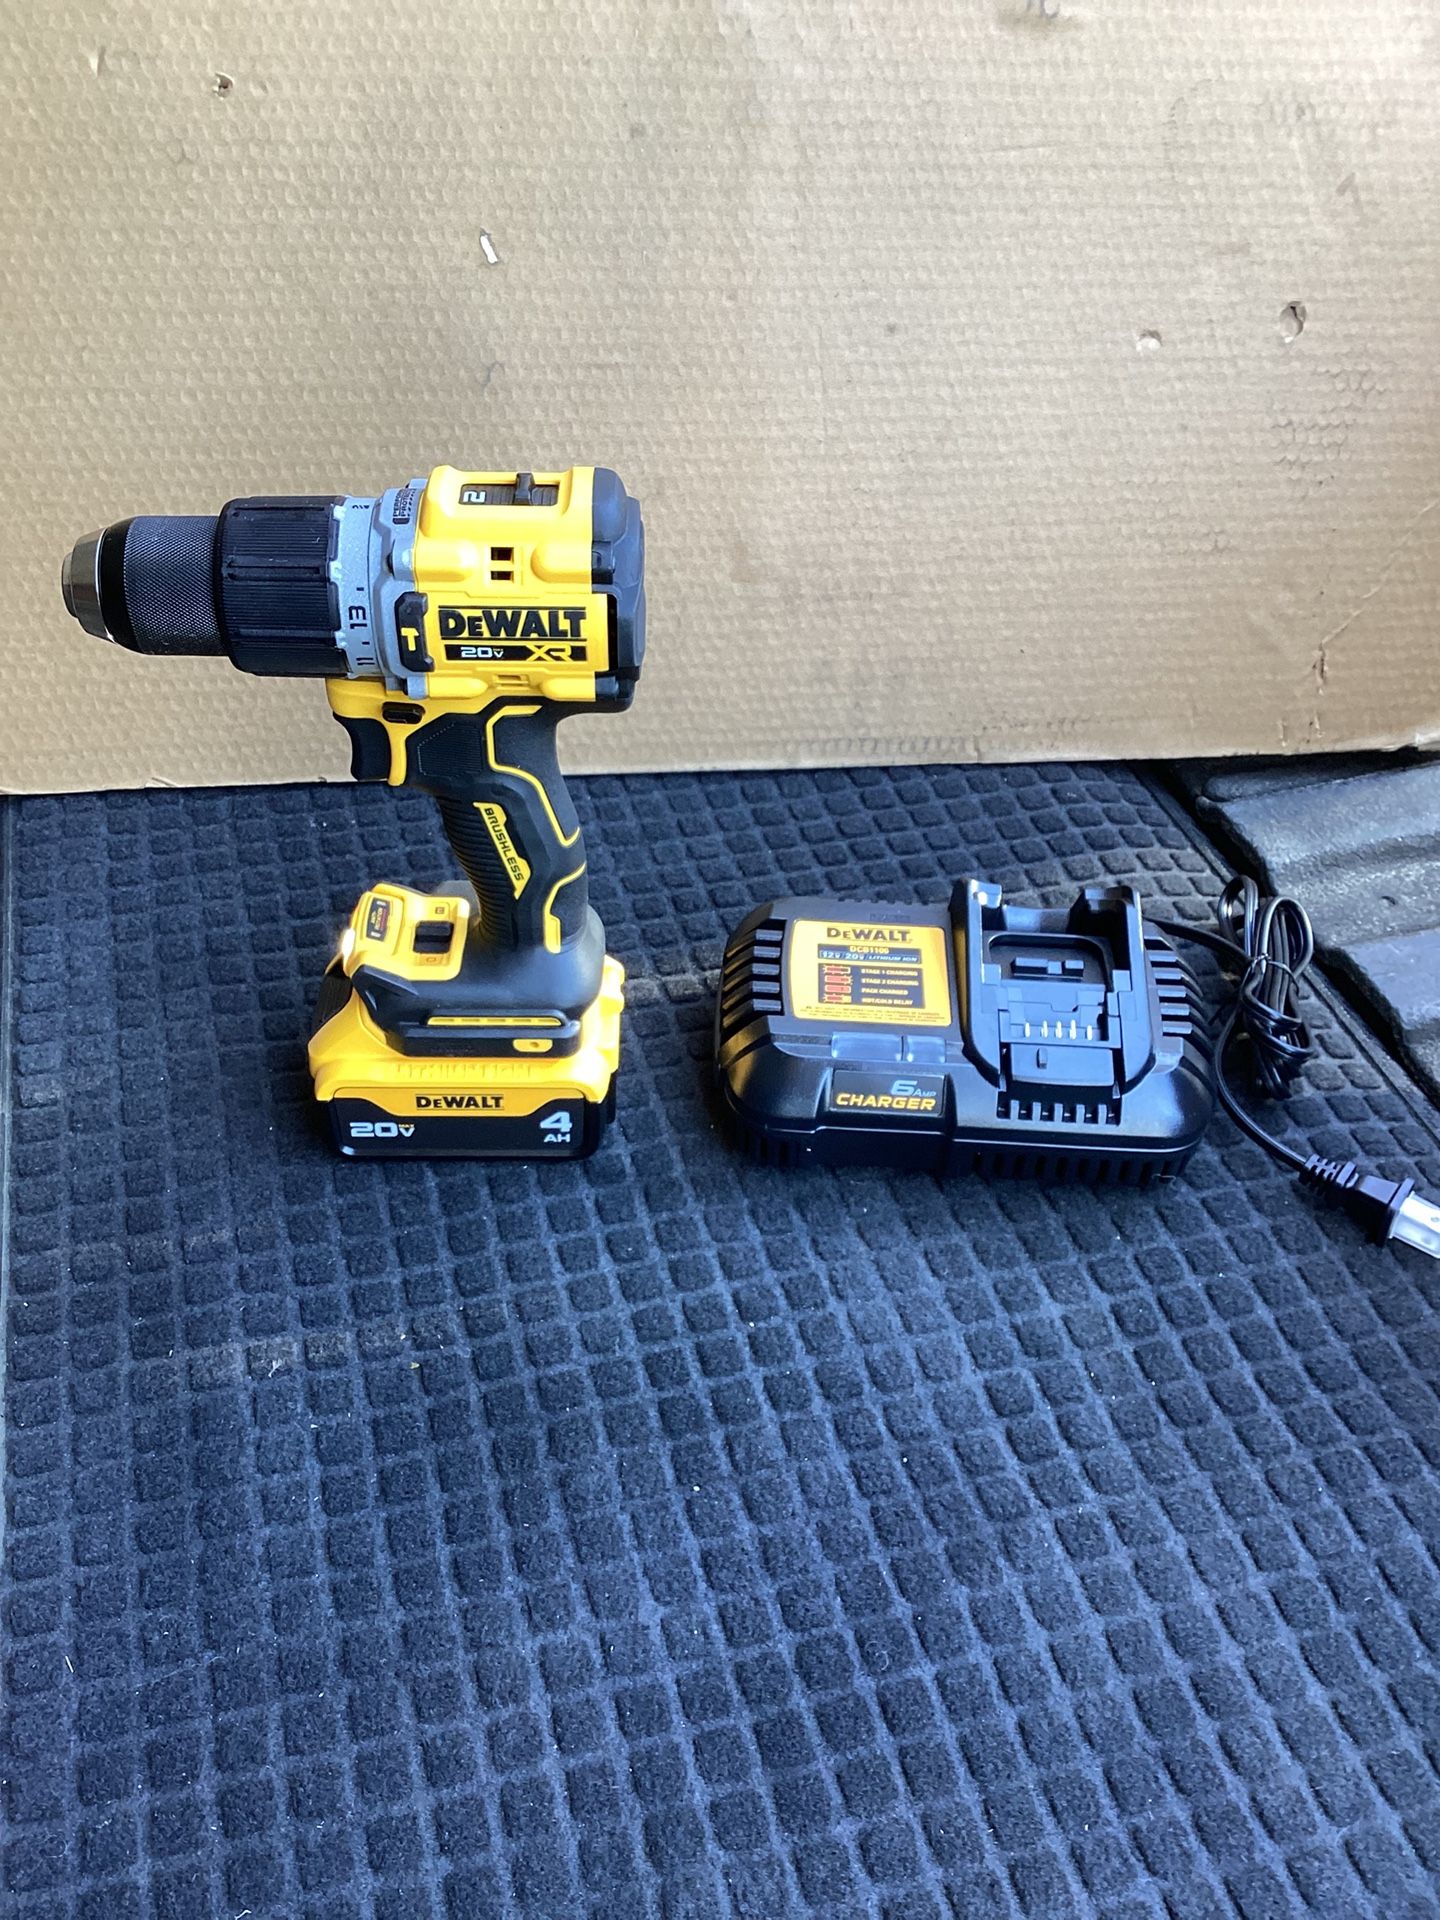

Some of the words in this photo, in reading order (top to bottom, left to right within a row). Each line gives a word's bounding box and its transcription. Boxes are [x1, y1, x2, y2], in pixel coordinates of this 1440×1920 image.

[348, 605, 368, 630] 13
[438, 609, 587, 638] DEWALT
[526, 644, 575, 662] XR
[484, 807, 525, 881] BRUSHLESS
[827, 927, 911, 943] DEWALT
[890, 1079, 918, 1096] 6
[415, 1095, 503, 1109] DEWALT
[836, 1094, 937, 1110] CHARGER
[350, 1122, 415, 1138] 20V
[540, 1112, 573, 1132] 4
[544, 1133, 571, 1144] AH
